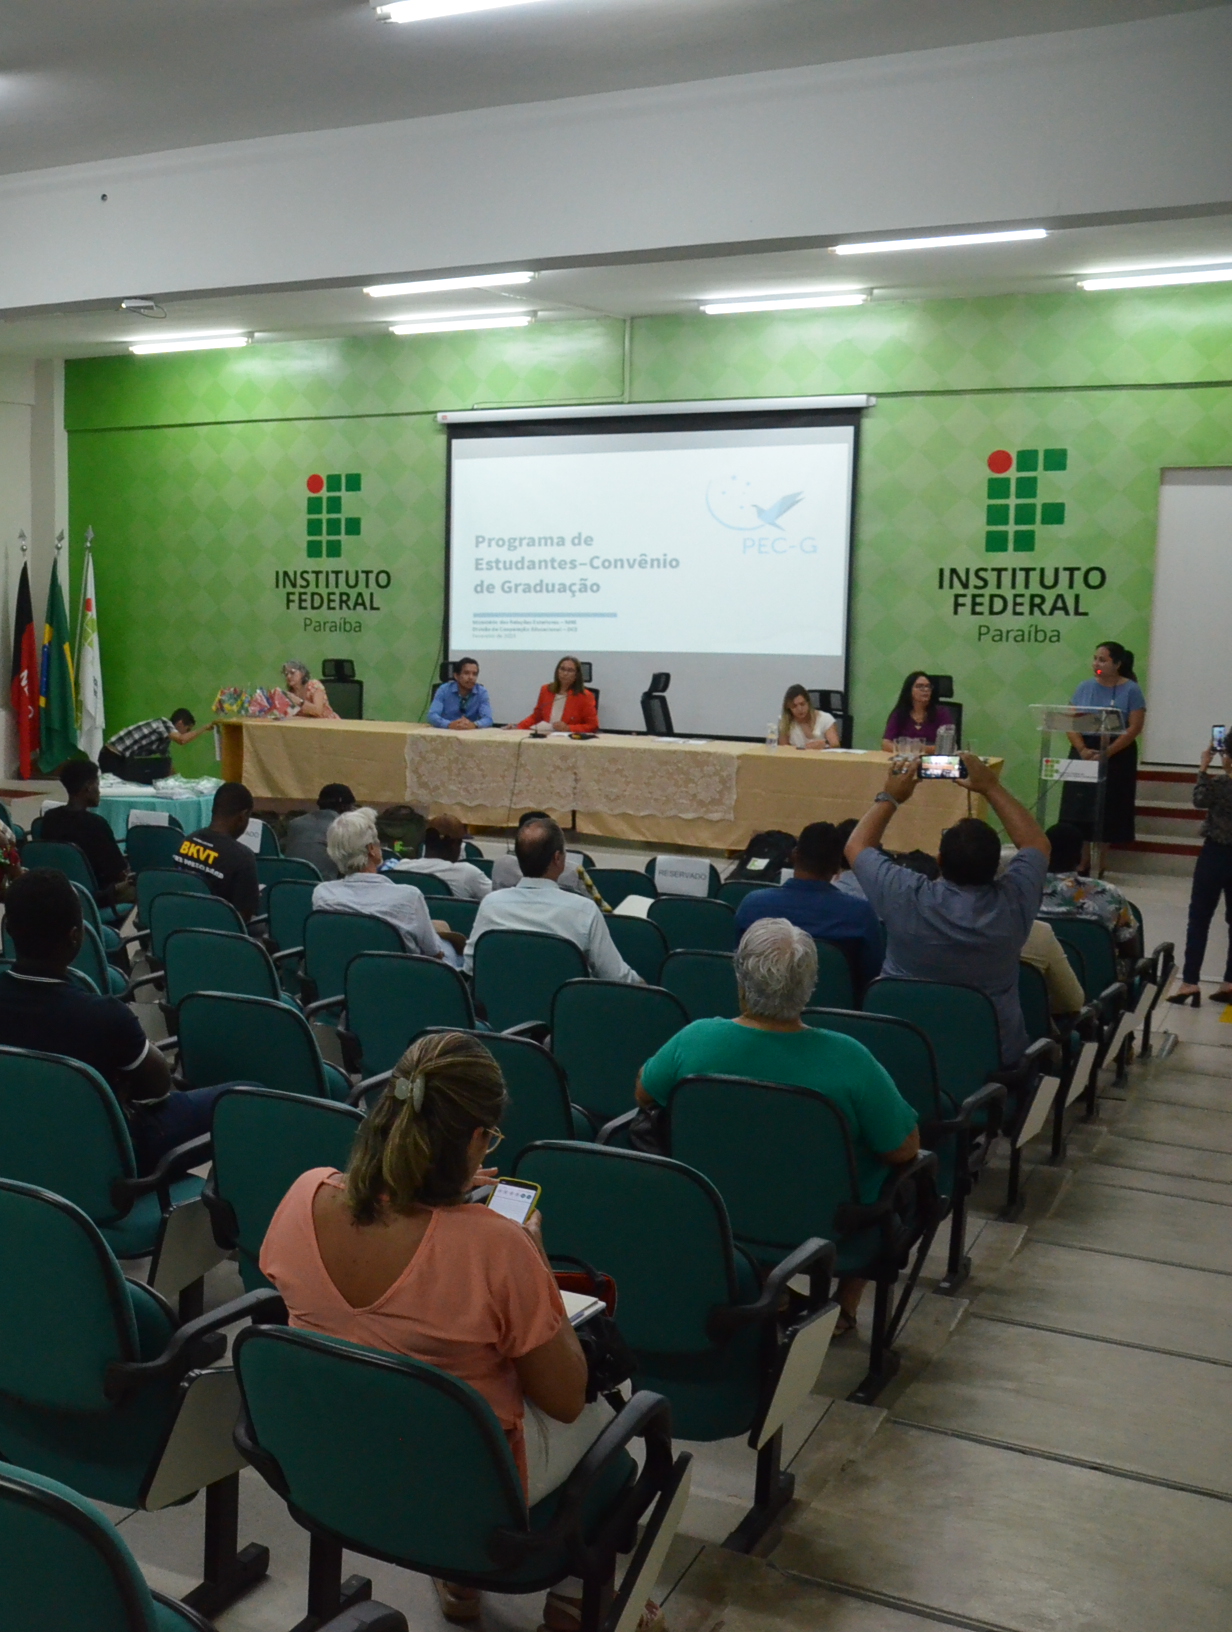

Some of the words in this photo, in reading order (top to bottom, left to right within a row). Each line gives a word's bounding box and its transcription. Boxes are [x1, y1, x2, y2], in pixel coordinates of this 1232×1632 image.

[474, 534, 566, 551] Programa
[571, 532, 594, 547] de
[742, 536, 818, 554] PEC-G
[275, 569, 392, 589] INSTITUTO
[473, 580, 496, 594] de
[501, 578, 601, 597] Graduação
[938, 566, 1107, 590] INSTITUTO
[286, 591, 381, 611] FEDERAL
[953, 593, 1089, 616] FEDERAL
[303, 617, 362, 633] Paraíba
[977, 624, 1061, 643] Paraíba
[179, 841, 219, 865] BKVT
[658, 869, 707, 881] RESERVADO
